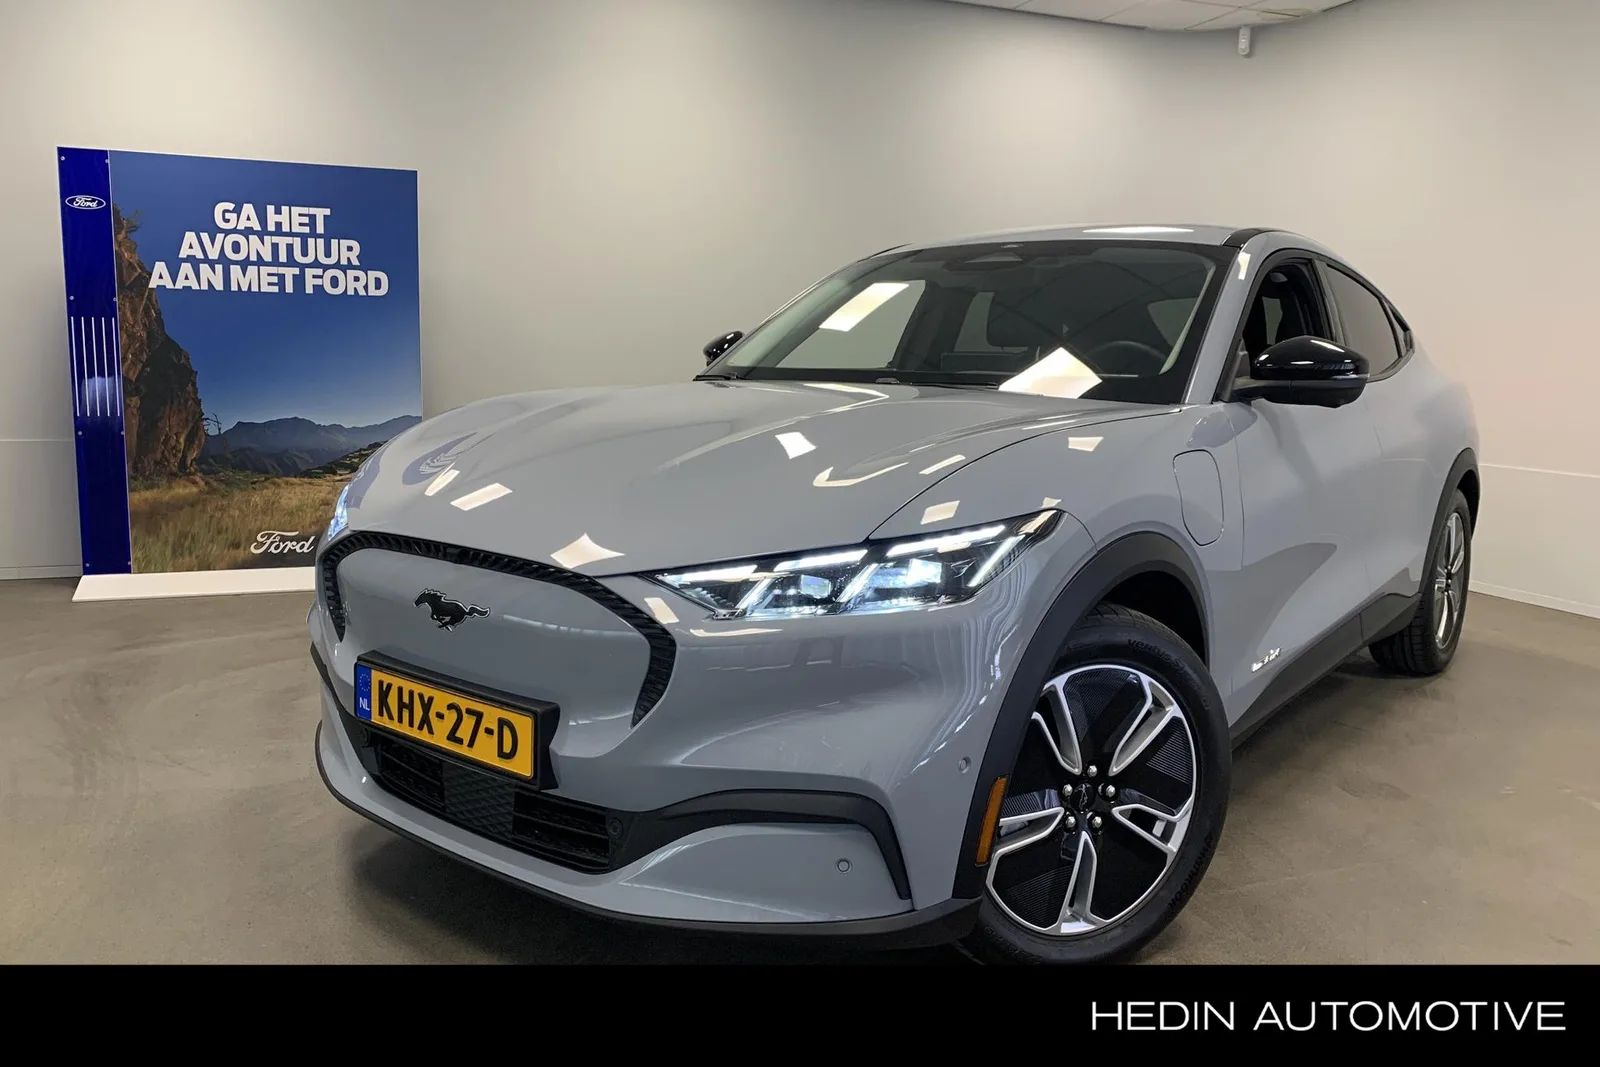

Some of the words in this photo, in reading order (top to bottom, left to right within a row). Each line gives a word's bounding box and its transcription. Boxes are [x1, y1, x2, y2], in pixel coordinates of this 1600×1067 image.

[73, 196, 99, 208] Ford
[214, 202, 263, 231] GA
[266, 205, 331, 234] HET
[179, 231, 361, 266] AVONTUUR
[148, 261, 224, 291] AAN
[230, 265, 299, 293] MET
[305, 268, 389, 296] FORD
[250, 530, 315, 554] Ford
[359, 697, 370, 711] NL
[377, 679, 519, 760] KHX-27-D
